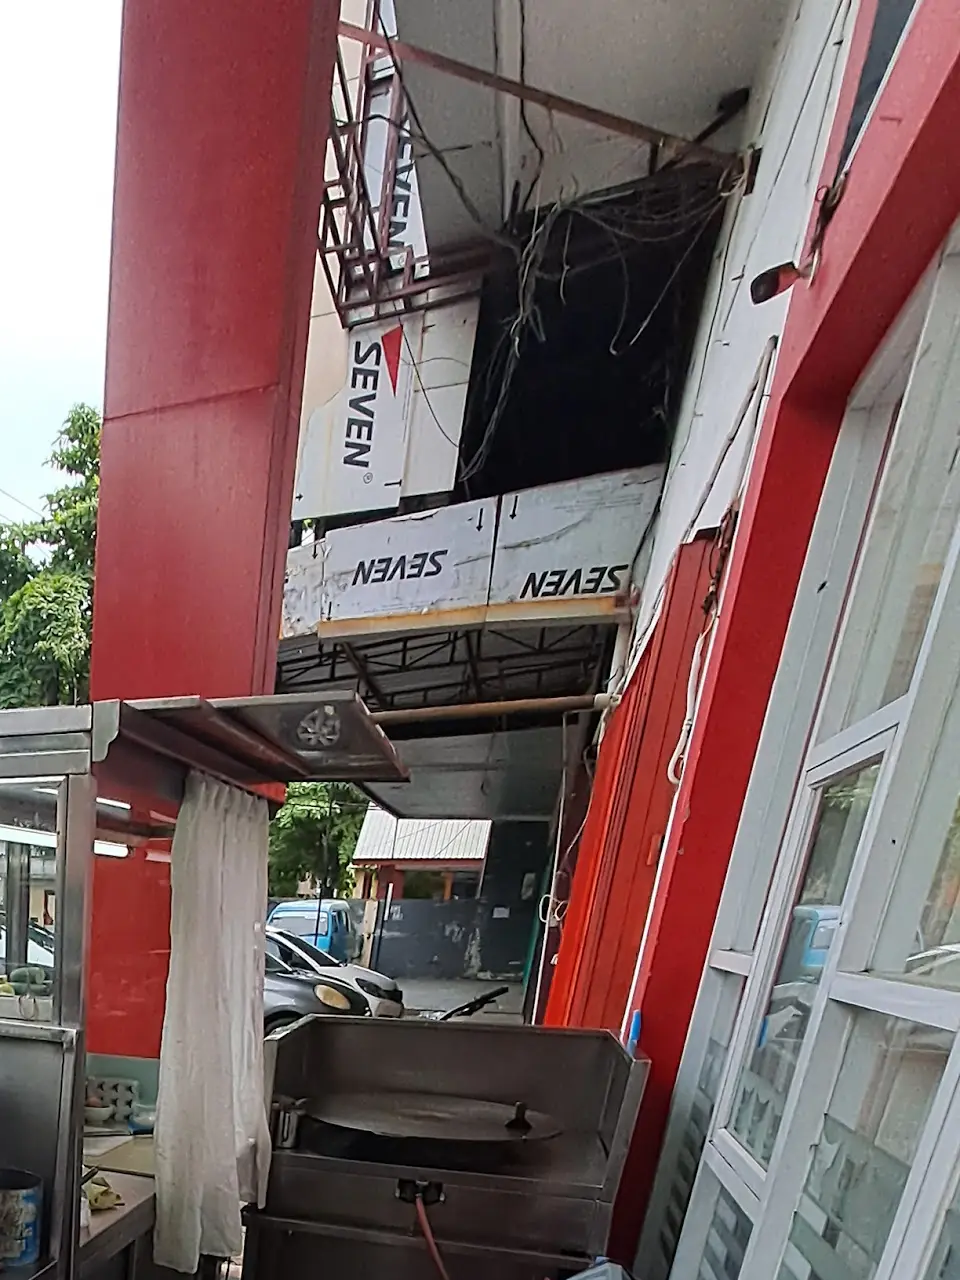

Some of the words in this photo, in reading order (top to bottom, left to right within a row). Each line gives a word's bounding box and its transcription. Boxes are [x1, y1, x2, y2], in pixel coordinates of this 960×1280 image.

[388, 120, 414, 248] EVEN
[342, 340, 381, 468] SEVEN
[352, 549, 448, 587] SEVEN
[519, 563, 629, 599] SEVEN
